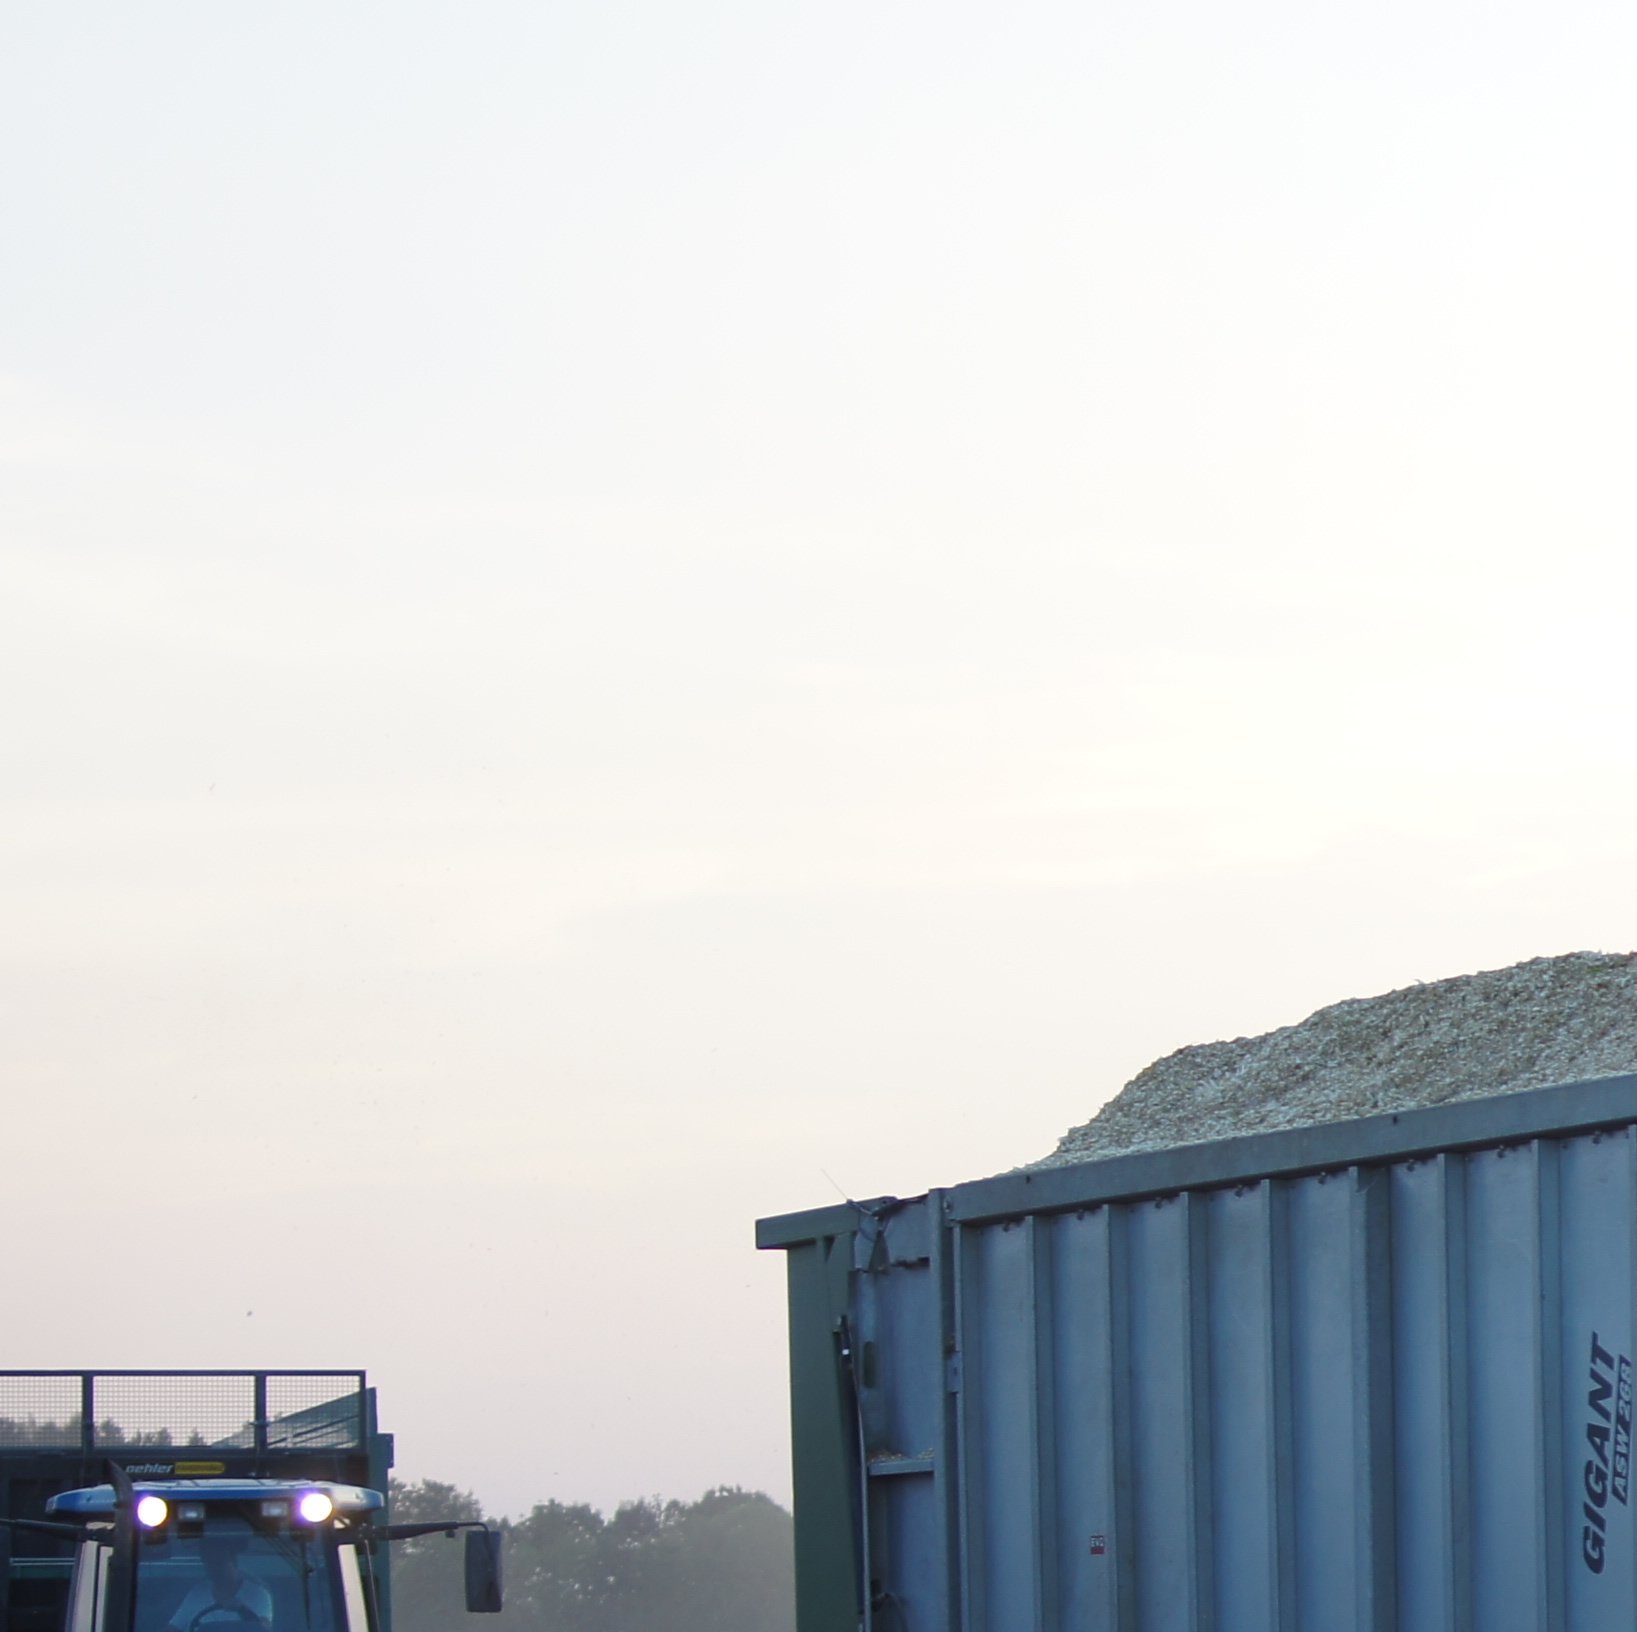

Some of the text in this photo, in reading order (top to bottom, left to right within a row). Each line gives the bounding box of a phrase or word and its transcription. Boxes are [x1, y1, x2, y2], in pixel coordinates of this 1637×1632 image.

[126, 1464, 174, 1474] oehler
[1583, 1331, 1616, 1575] GIGANT
[1613, 1423, 1630, 1497] ASW
